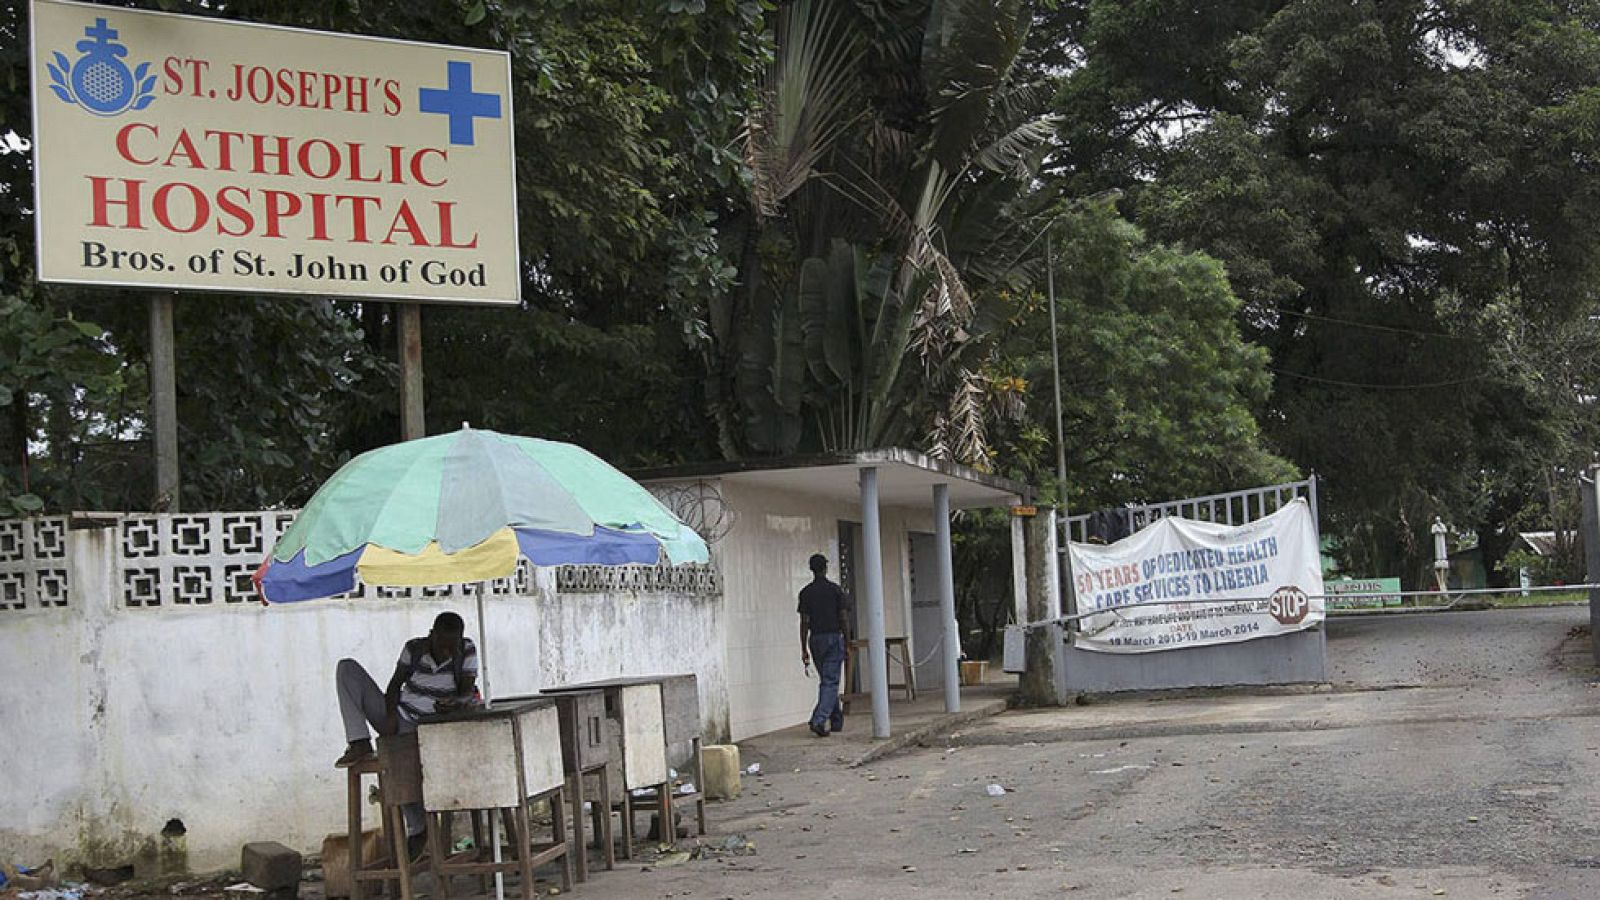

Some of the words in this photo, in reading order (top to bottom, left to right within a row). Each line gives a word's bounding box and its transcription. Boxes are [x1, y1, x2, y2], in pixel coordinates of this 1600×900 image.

[163, 56, 217, 99] ST.
[115, 123, 449, 187] CATHOLIC
[86, 176, 478, 249] HOSPITAL
[82, 241, 175, 273] Bros.
[188, 248, 225, 274] of
[233, 251, 275, 277] St.
[287, 254, 368, 282] John
[380, 259, 413, 283] of
[421, 260, 487, 287] God
[1076, 573, 1093, 594] 50
[1094, 563, 1139, 590] YEARS
[1142, 558, 1156, 580] OF
[1227, 536, 1277, 566] HEALTH
[1193, 572, 1211, 594] TO
[1213, 563, 1269, 592] LIBERIA
[1271, 589, 1307, 617] STOP
[1124, 636, 1155, 646] March
[1158, 631, 1198, 644] 2013-19
[1200, 627, 1232, 639] March
[1234, 621, 1260, 634] 2014
